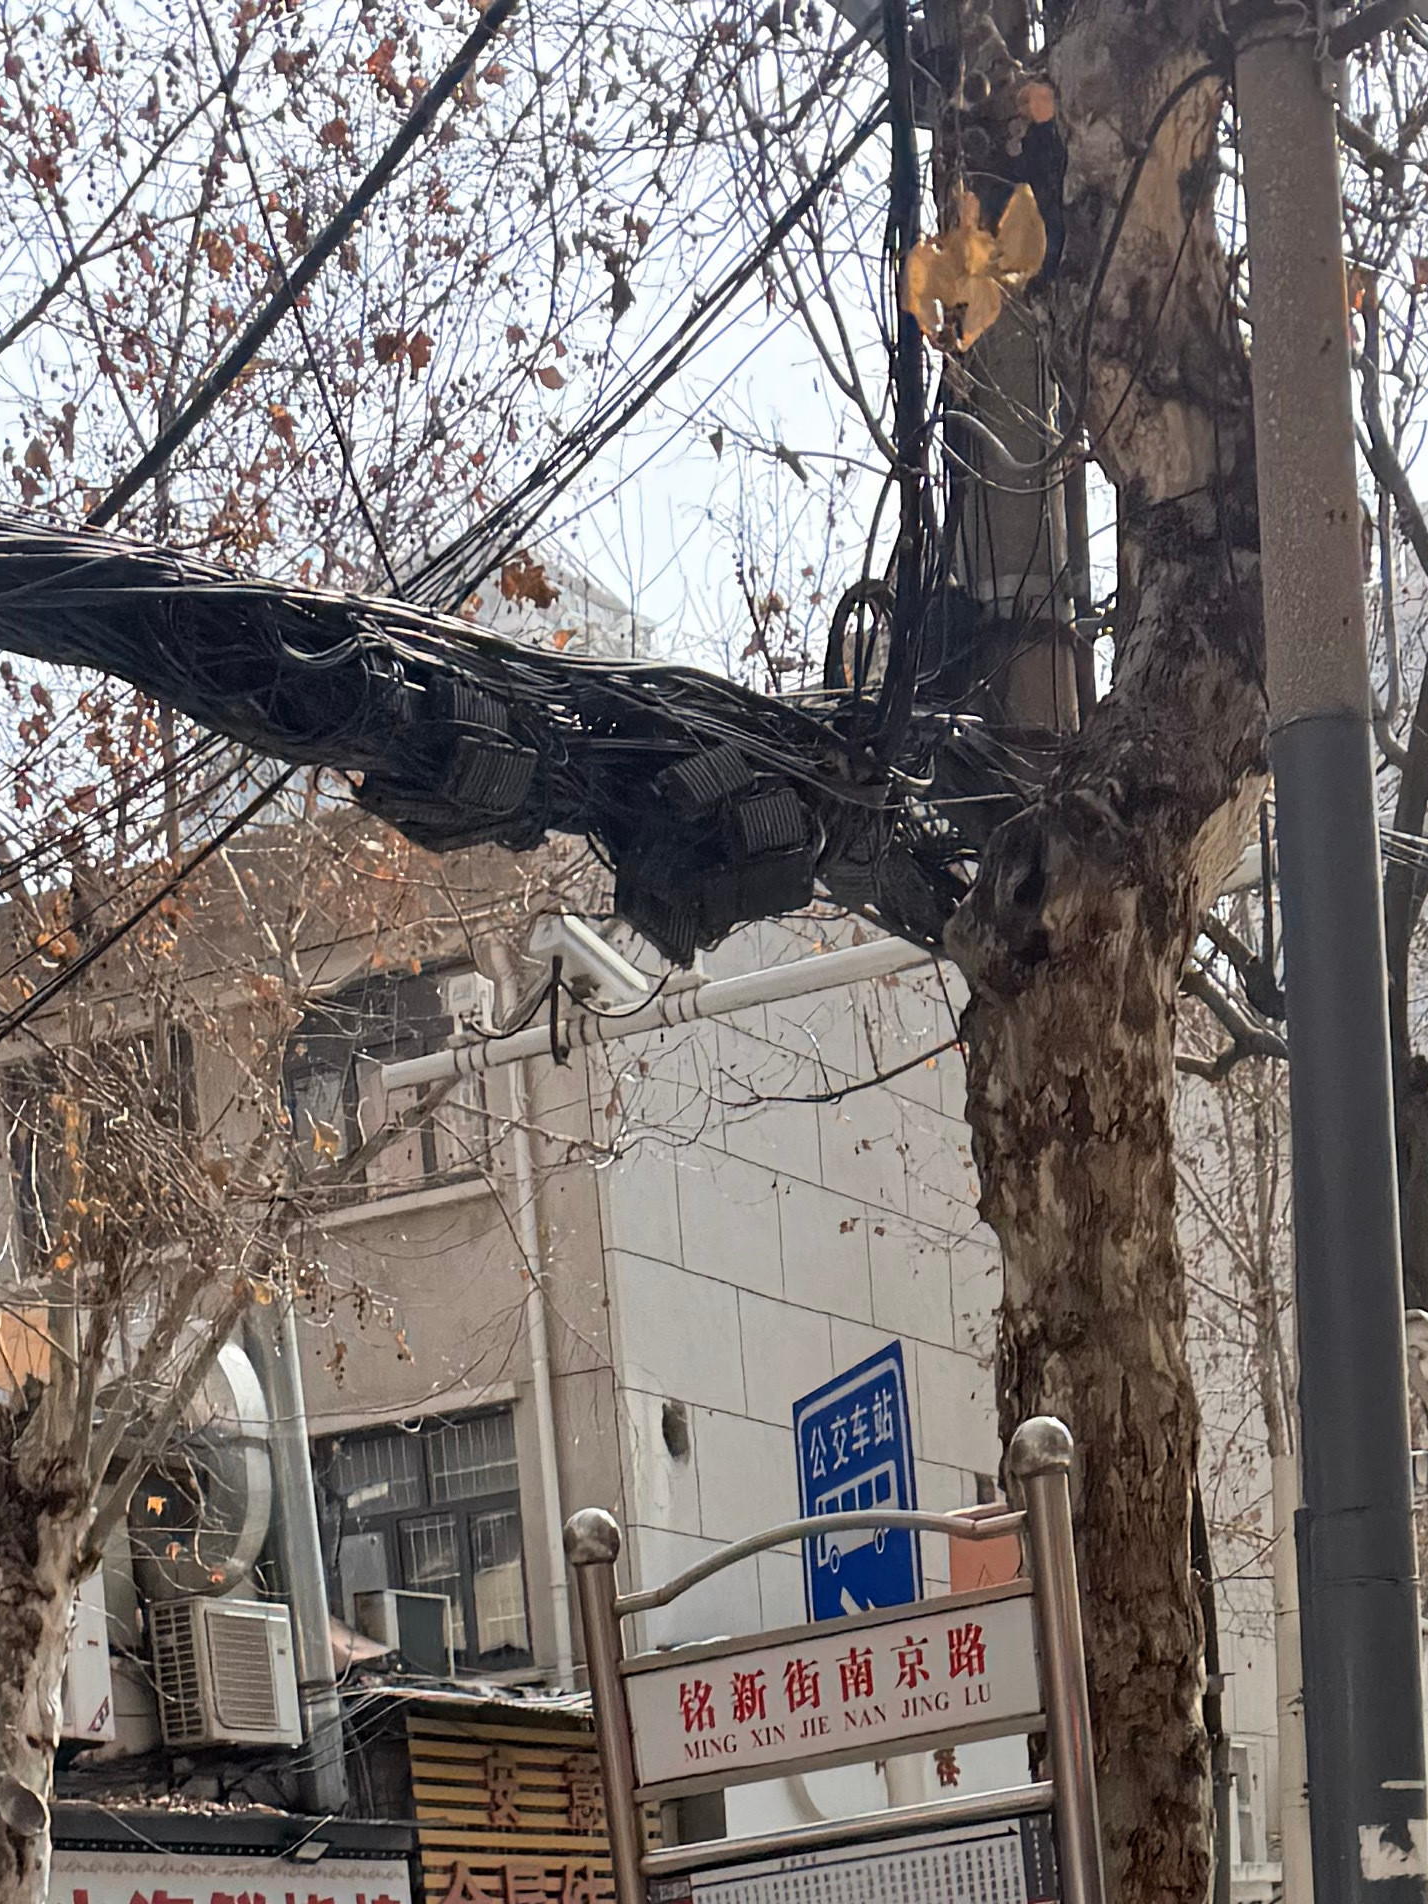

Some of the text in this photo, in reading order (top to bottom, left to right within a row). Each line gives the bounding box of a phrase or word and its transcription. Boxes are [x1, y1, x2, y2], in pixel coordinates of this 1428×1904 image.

[809, 1388, 894, 1480] 公交车站
[678, 1622, 987, 1734] 铭新街南京路
[684, 1682, 992, 1761] MING XIN JIE NAN JING LU
